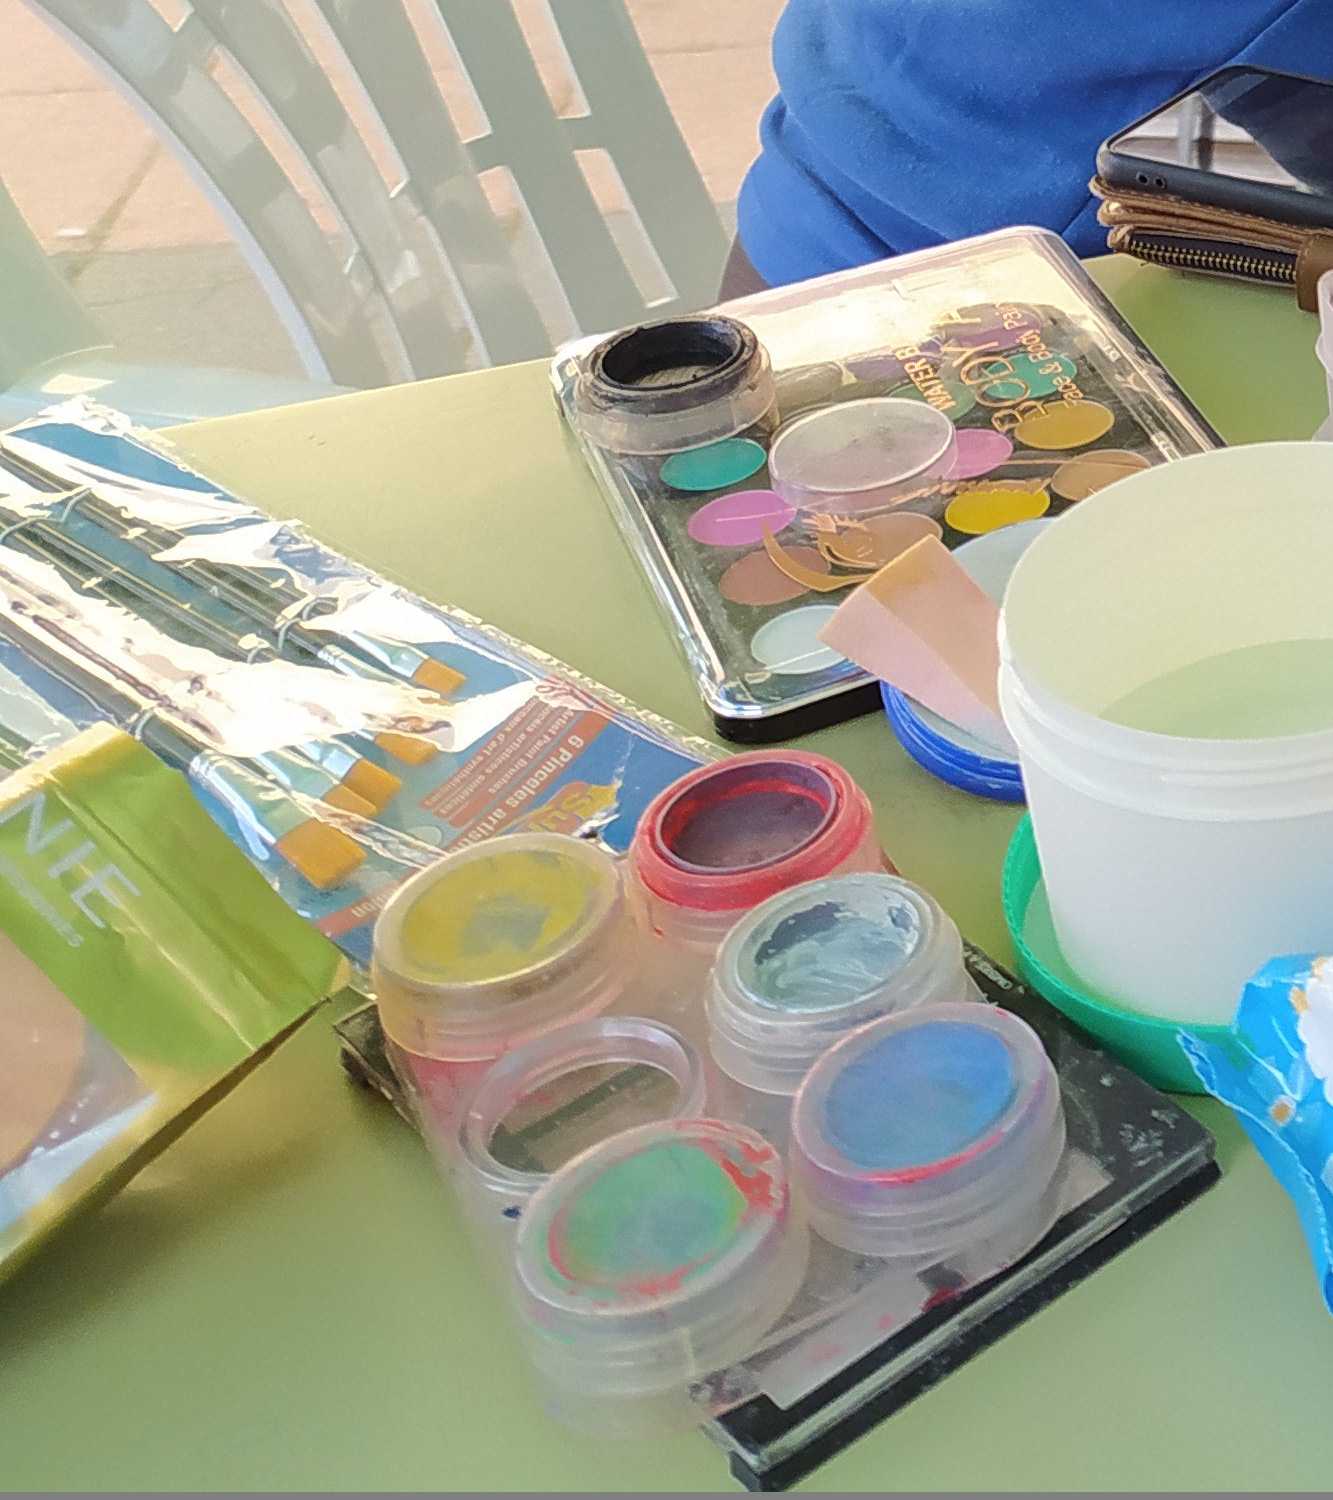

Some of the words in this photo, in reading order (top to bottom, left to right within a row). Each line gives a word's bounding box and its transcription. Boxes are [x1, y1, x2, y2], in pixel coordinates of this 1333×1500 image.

[1016, 331, 1053, 362] Body
[904, 357, 955, 409] WATER
[940, 342, 1047, 431] BODY
[547, 708, 573, 736] Artist
[524, 732, 551, 759] Paint
[567, 733, 583, 749] 6
[487, 757, 527, 795] Brushes
[504, 746, 572, 810] Pinceles
